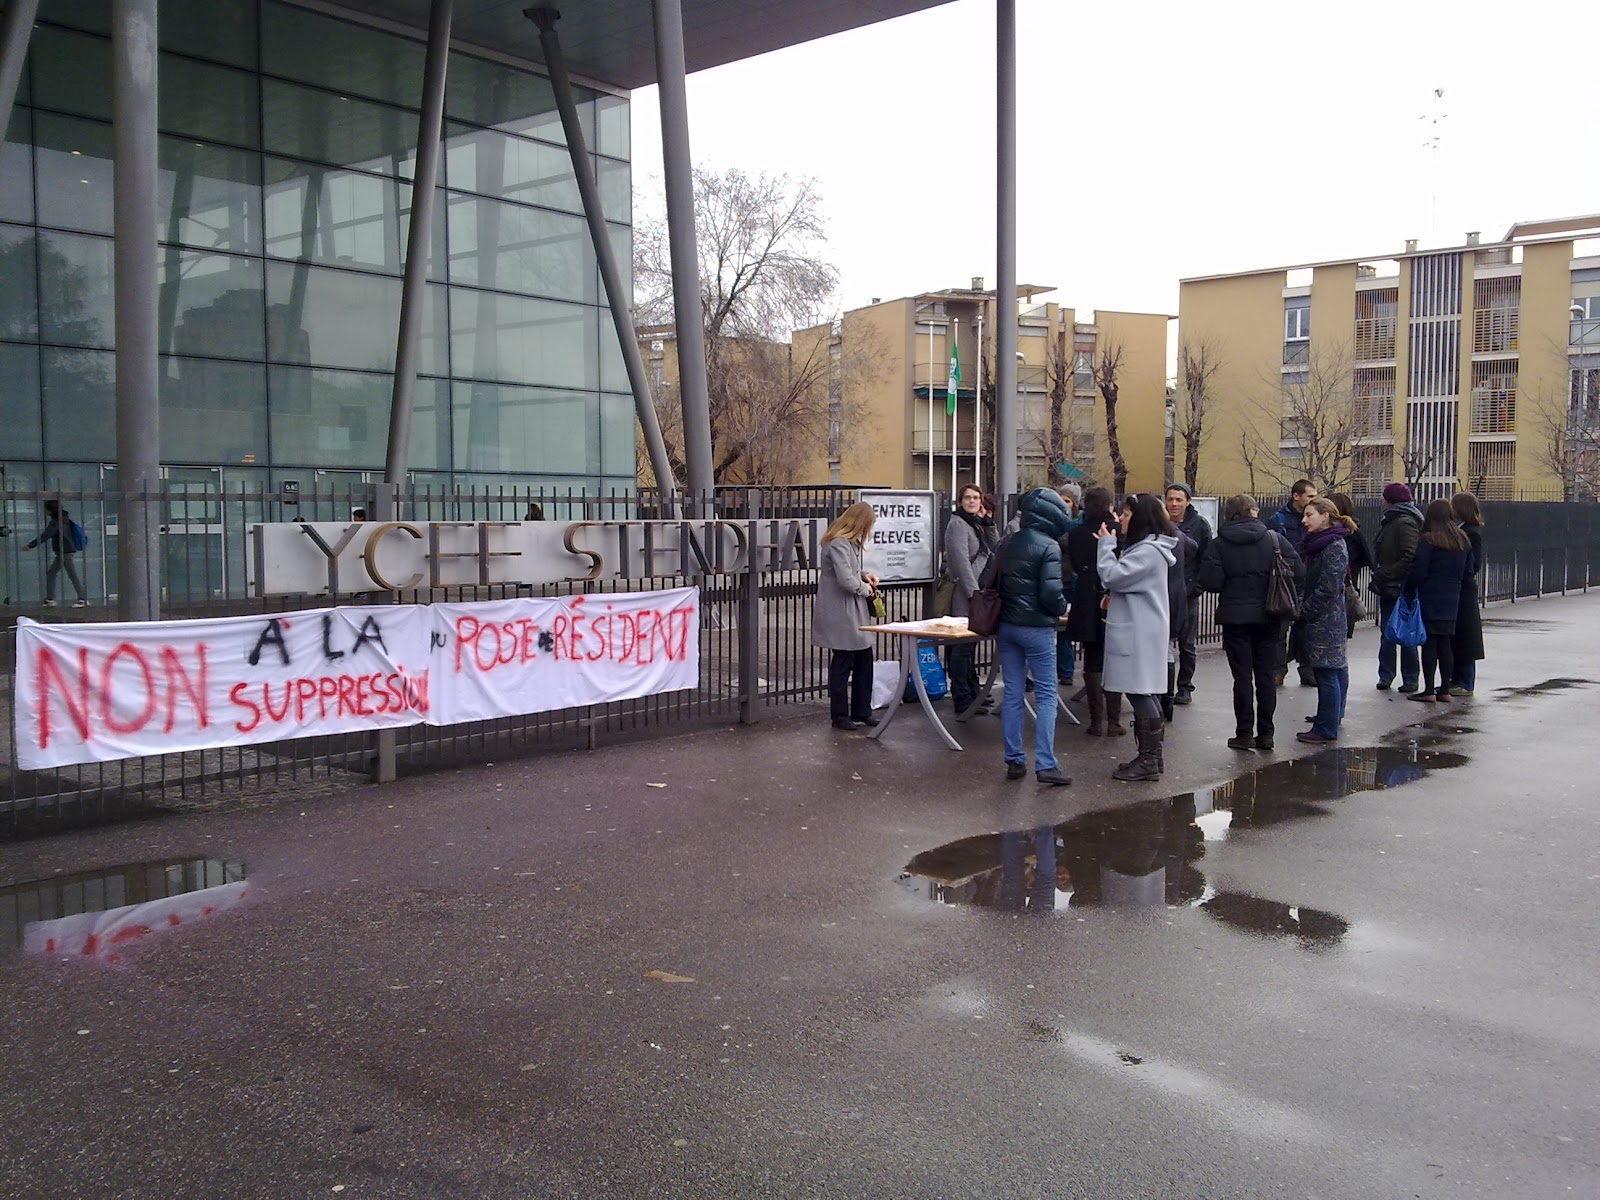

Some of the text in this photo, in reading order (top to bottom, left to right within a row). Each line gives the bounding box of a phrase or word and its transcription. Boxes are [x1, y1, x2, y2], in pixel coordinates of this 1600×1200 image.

[872, 504, 921, 518] ENTREE
[873, 530, 921, 544] ELEVES
[321, 614, 389, 662] LA
[455, 615, 541, 674] POSTE
[37, 641, 210, 750] NON
